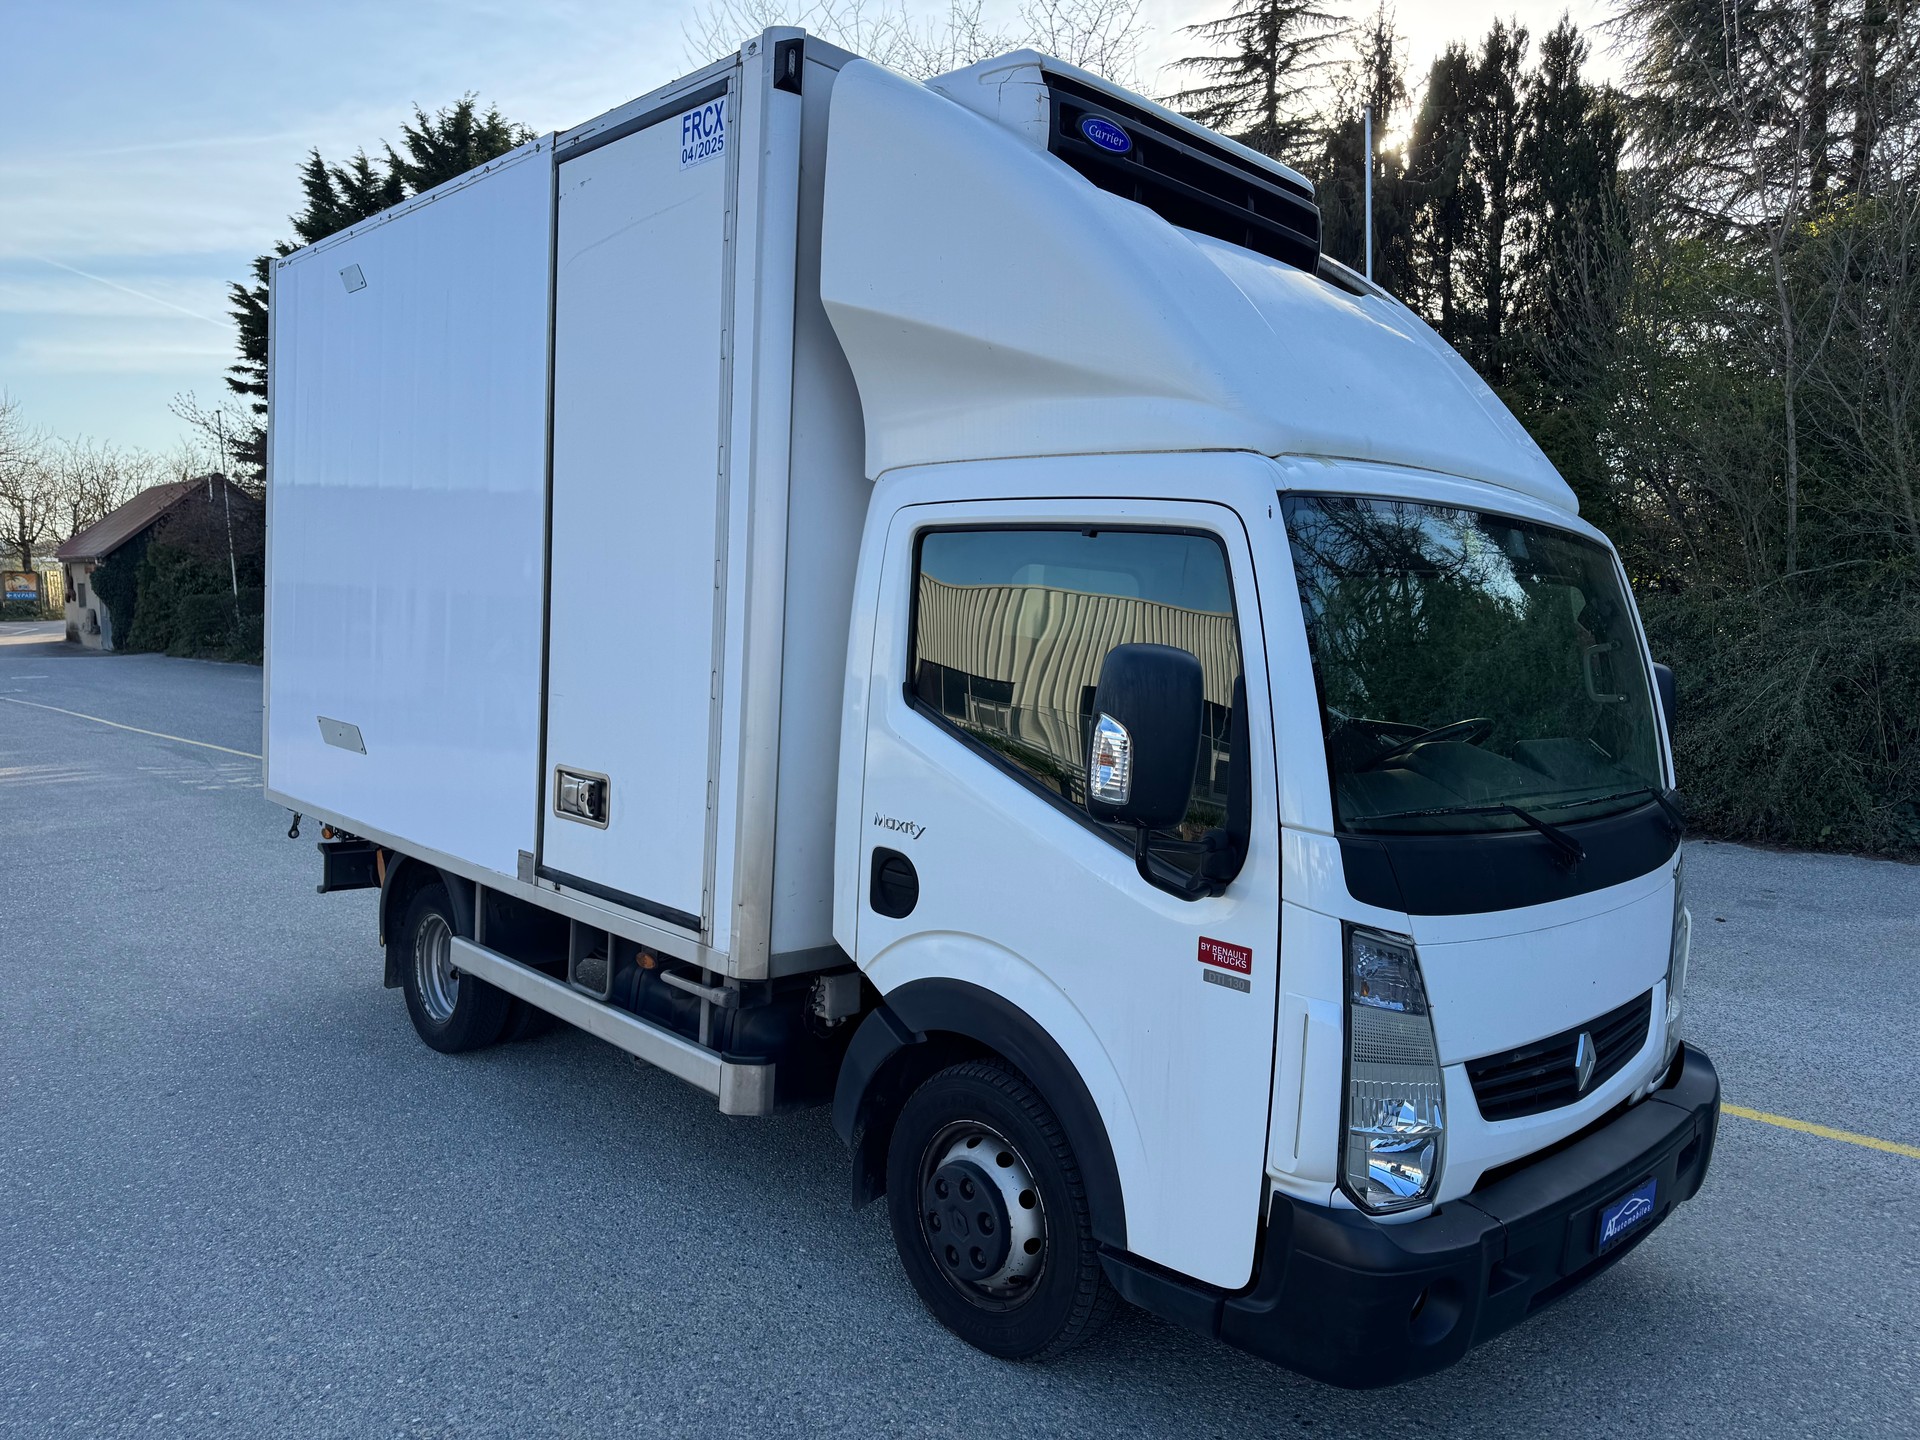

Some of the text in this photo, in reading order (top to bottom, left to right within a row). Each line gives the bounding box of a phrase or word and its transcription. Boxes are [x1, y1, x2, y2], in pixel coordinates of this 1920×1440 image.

[682, 100, 724, 146] FRCX
[1089, 125, 1124, 146] Carrier
[682, 134, 724, 164] 04/2025
[874, 812, 926, 840] Maxity
[1201, 942, 1247, 960] BY RENAULT
[1212, 952, 1247, 969] TRUCKS
[1208, 972, 1245, 990] DTI 130
